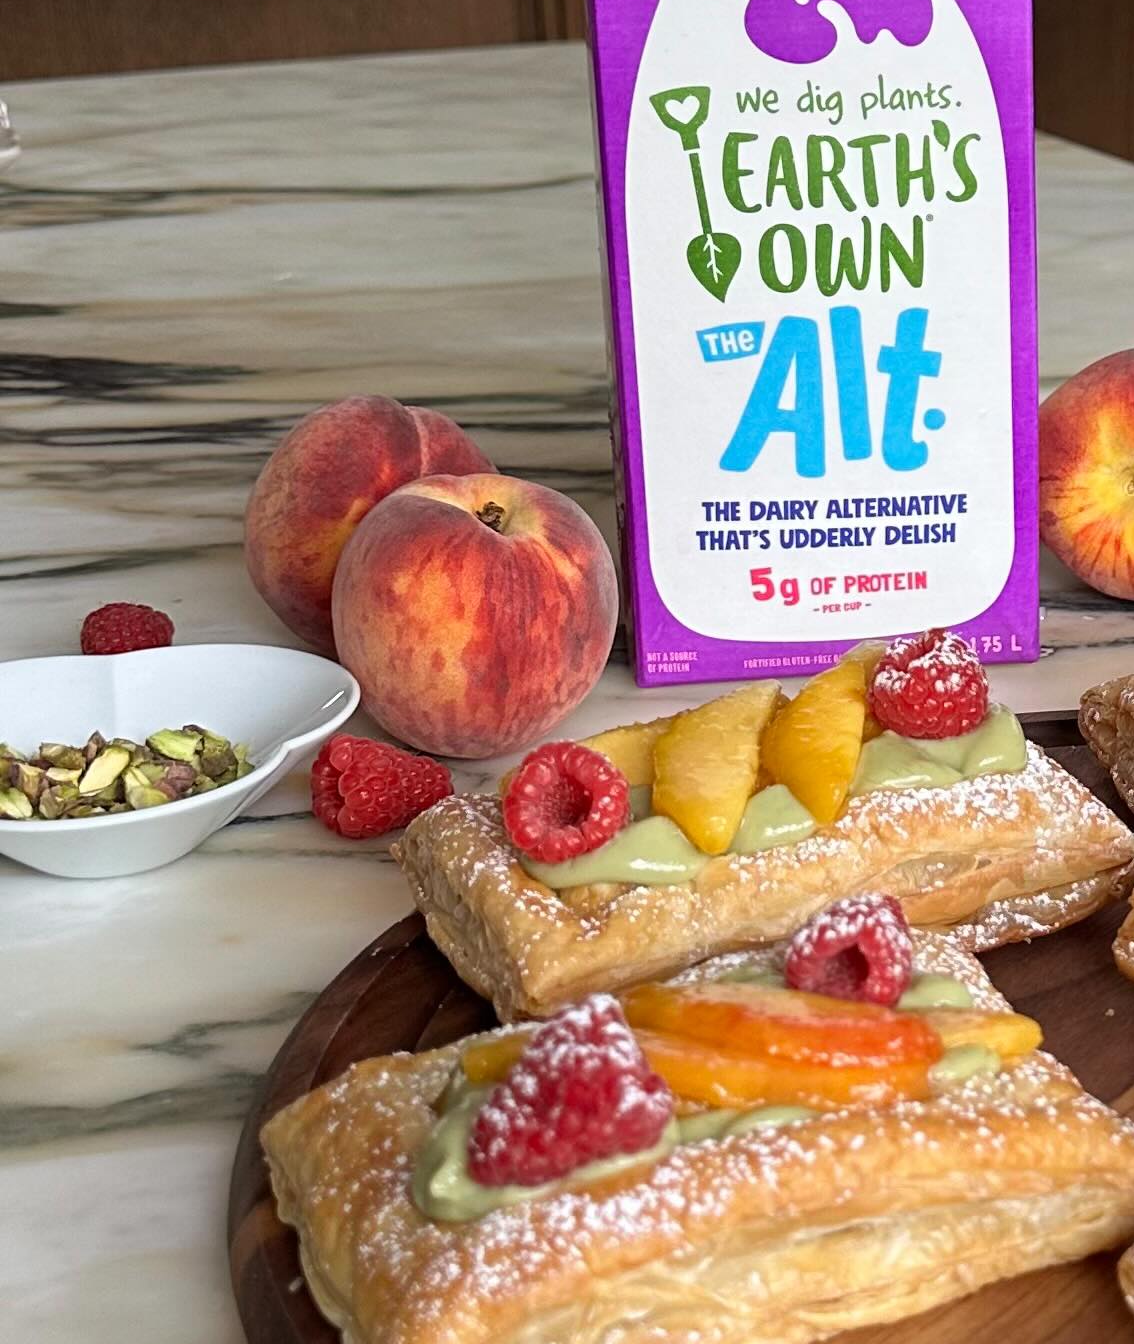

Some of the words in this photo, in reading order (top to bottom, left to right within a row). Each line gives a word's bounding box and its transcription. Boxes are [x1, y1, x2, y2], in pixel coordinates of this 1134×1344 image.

[735, 86, 780, 115] we
[796, 80, 844, 125] dig
[860, 74, 963, 120] plants.
[721, 119, 982, 214] EARTH'S
[757, 214, 926, 297] OWN
[719, 305, 947, 478] Alt.
[701, 501, 741, 523] THE
[749, 499, 819, 522] DAIRY
[825, 493, 968, 520] ALTERNATIVE
[695, 528, 771, 552] THAT'S
[779, 526, 878, 550] UDDERLY
[884, 523, 957, 547] DELISH
[749, 567, 800, 607] 5g
[810, 576, 837, 596] OF
[843, 570, 928, 594] PROTEIN
[822, 603, 841, 614] PER
[843, 601, 863, 612] CUP
[1010, 634, 1023, 652] L
